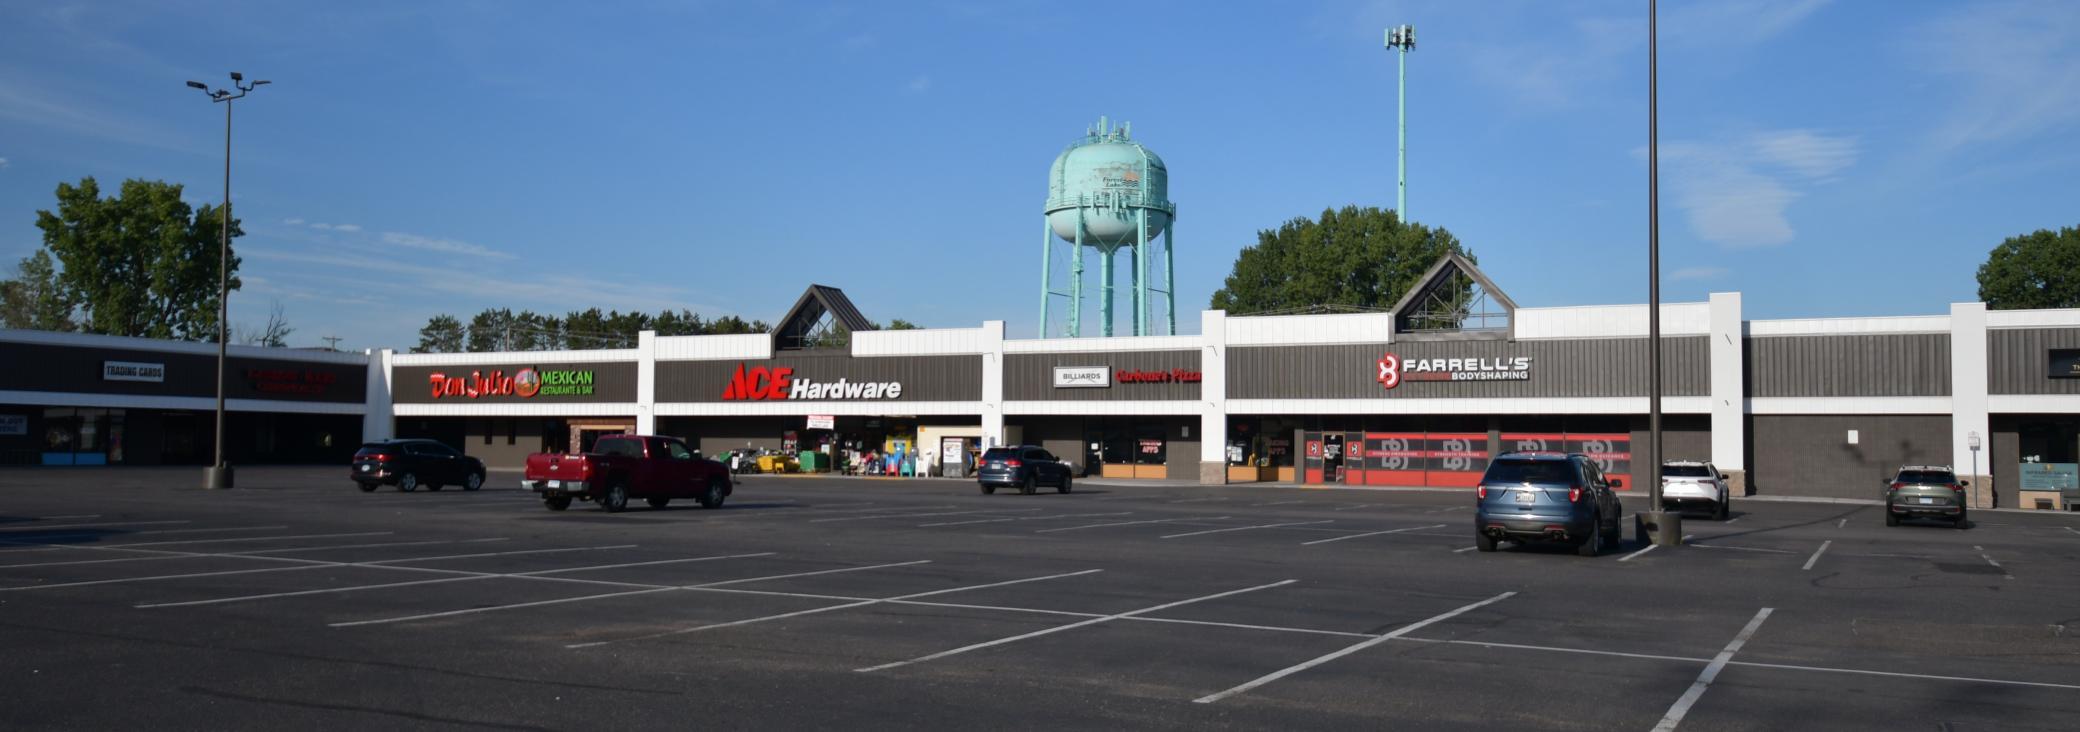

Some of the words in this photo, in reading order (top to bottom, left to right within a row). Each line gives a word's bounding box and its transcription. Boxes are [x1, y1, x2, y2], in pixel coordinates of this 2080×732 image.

[1403, 357, 1529, 372] FARRELL'S
[106, 366, 136, 376] TRADING
[139, 367, 162, 378] CARDS
[541, 371, 592, 385] MEXICAN
[1451, 371, 1528, 381] BODYSHAPING
[430, 373, 465, 398] Don
[723, 362, 793, 400] ACE
[789, 377, 901, 399] Hardware
